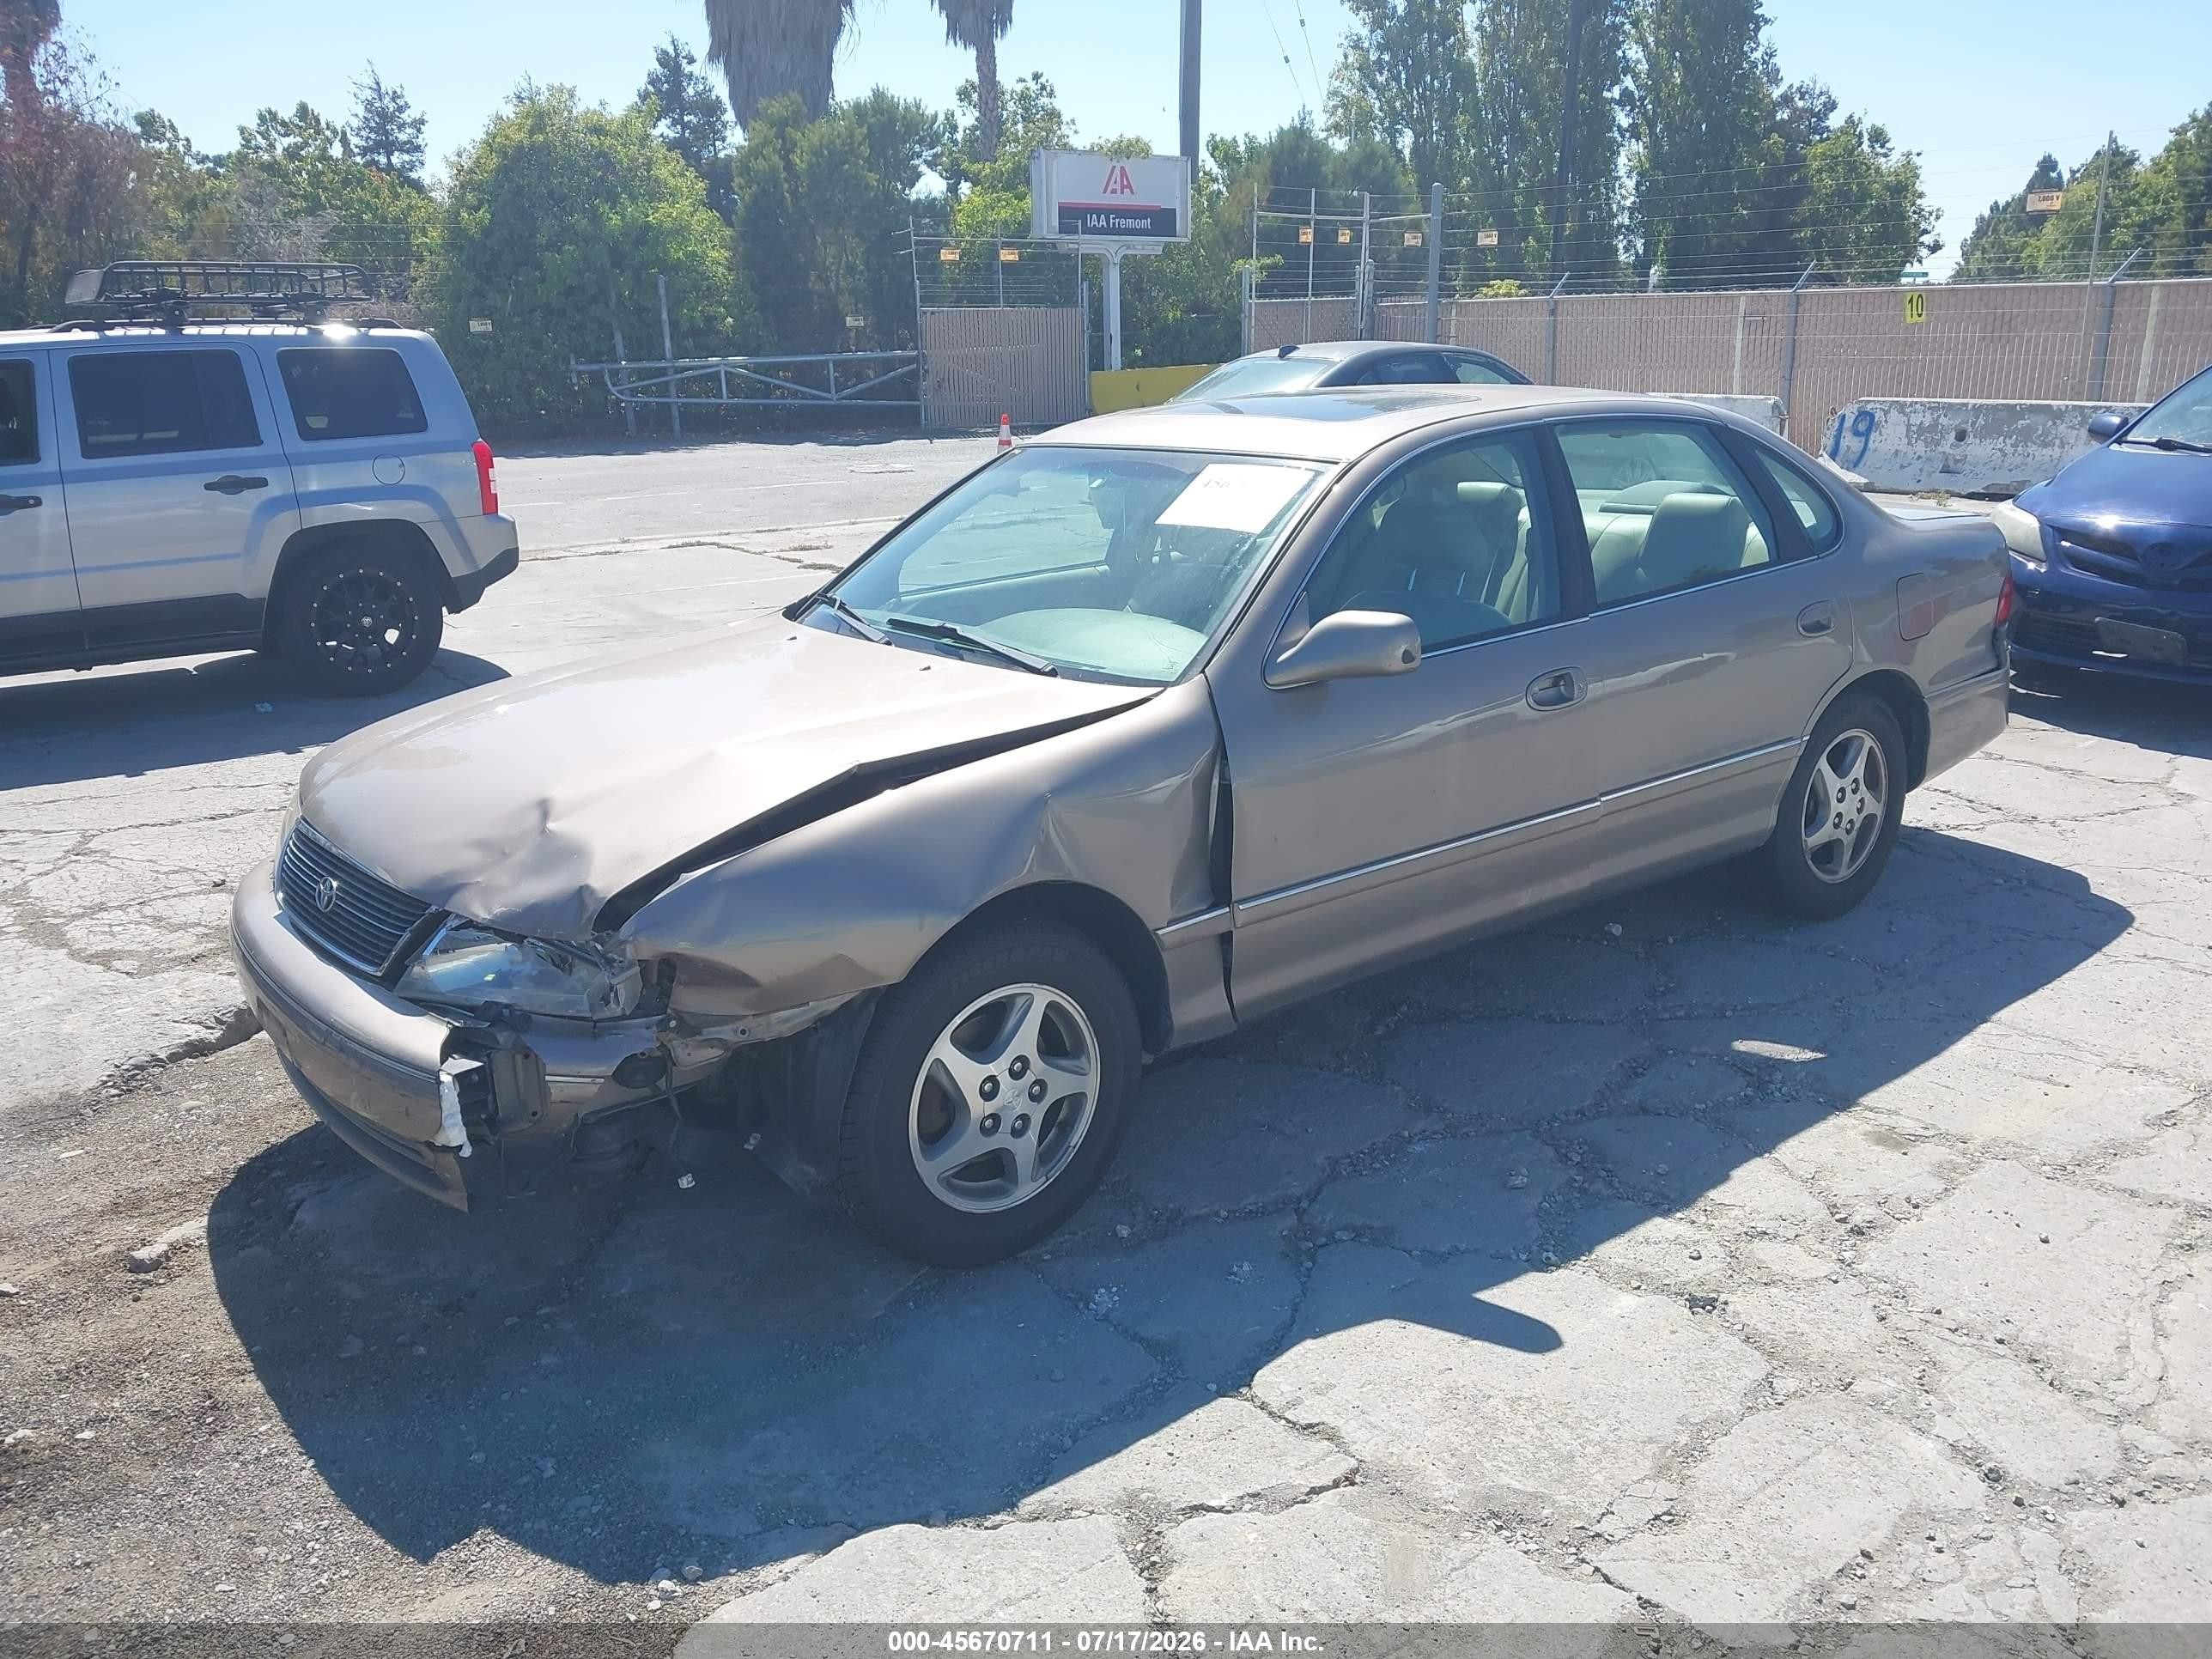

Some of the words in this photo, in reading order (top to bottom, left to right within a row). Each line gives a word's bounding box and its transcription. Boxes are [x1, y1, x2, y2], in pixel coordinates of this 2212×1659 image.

[1086, 214, 1107, 228] IAA
[1109, 214, 1152, 229] Fremont
[1907, 294, 1924, 319] 10
[1829, 410, 1875, 468] 19
